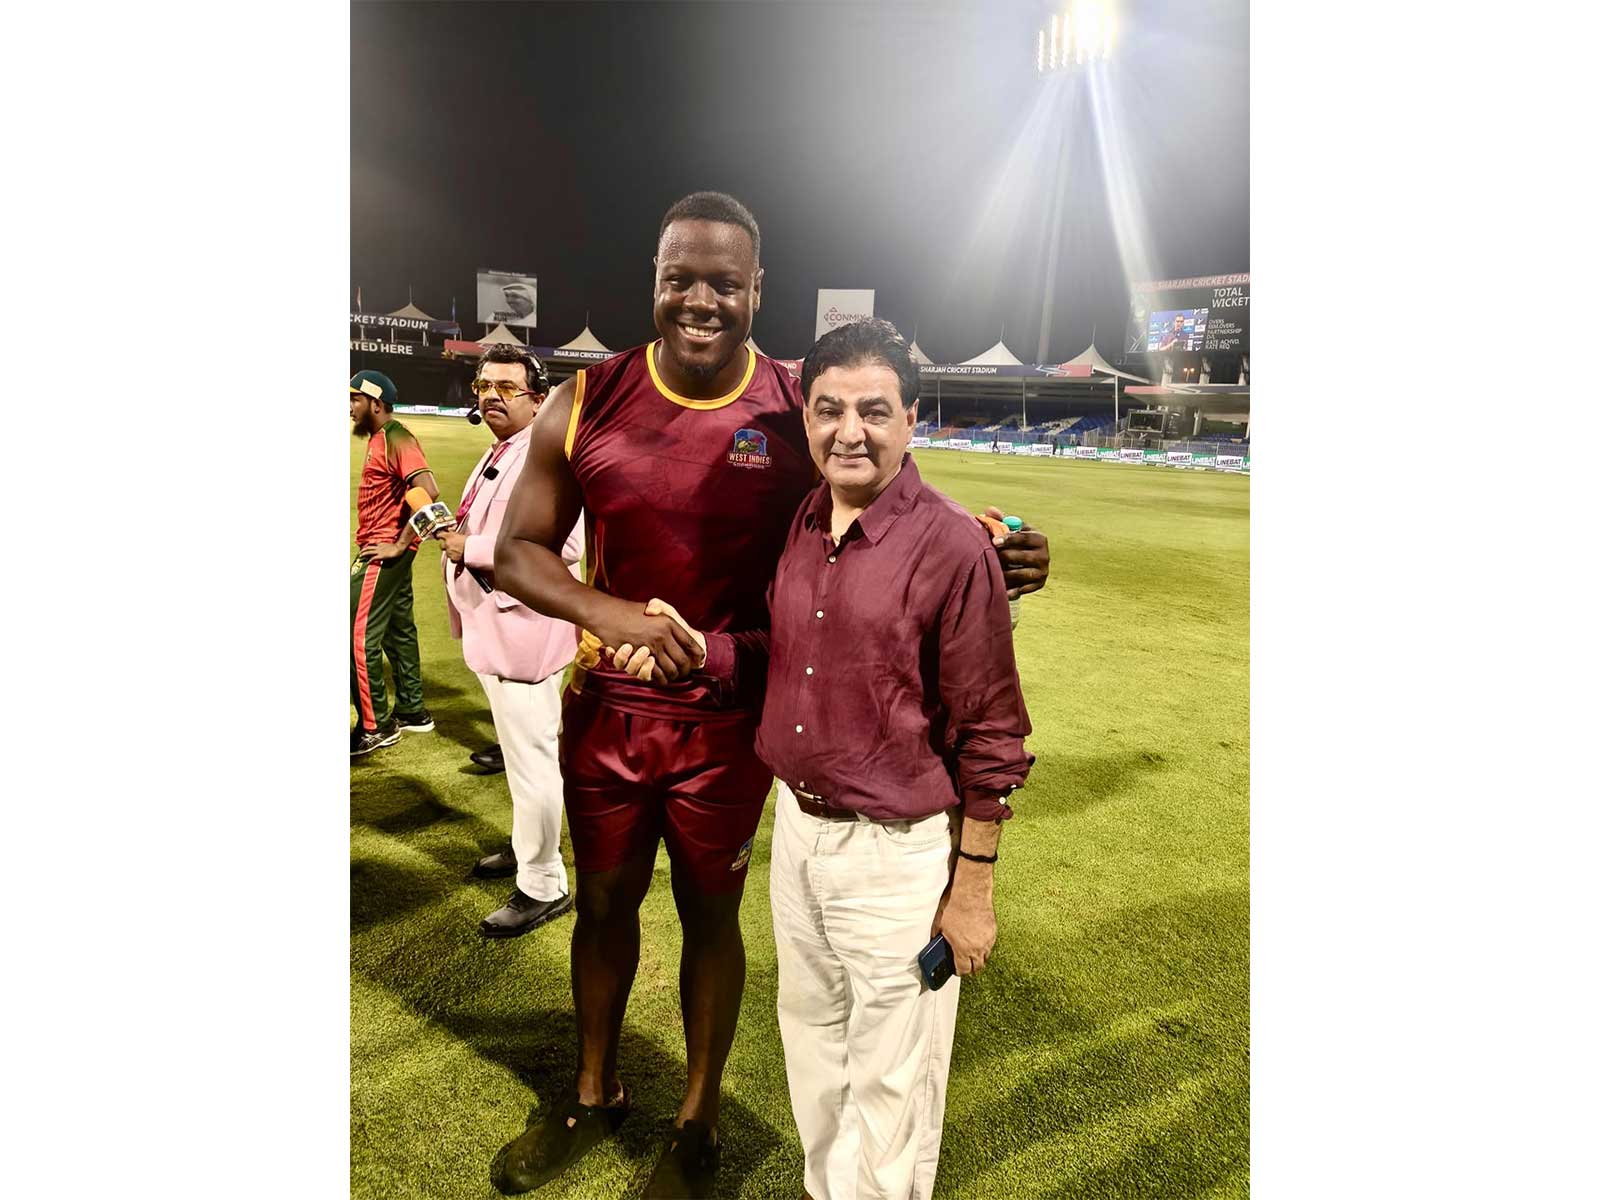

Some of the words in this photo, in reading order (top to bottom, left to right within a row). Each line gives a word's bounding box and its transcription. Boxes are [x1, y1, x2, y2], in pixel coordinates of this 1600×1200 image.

[1193, 276, 1226, 287] CRICKET
[1213, 287, 1243, 298] TOTAL
[1211, 297, 1250, 308] WICKET
[378, 316, 429, 330] STADIUM
[380, 343, 413, 355] HERE
[729, 452, 747, 462] WEST
[749, 454, 770, 465] INDIES
[1168, 454, 1190, 462] LINEBAT
[1217, 458, 1241, 466] LINEBAT
